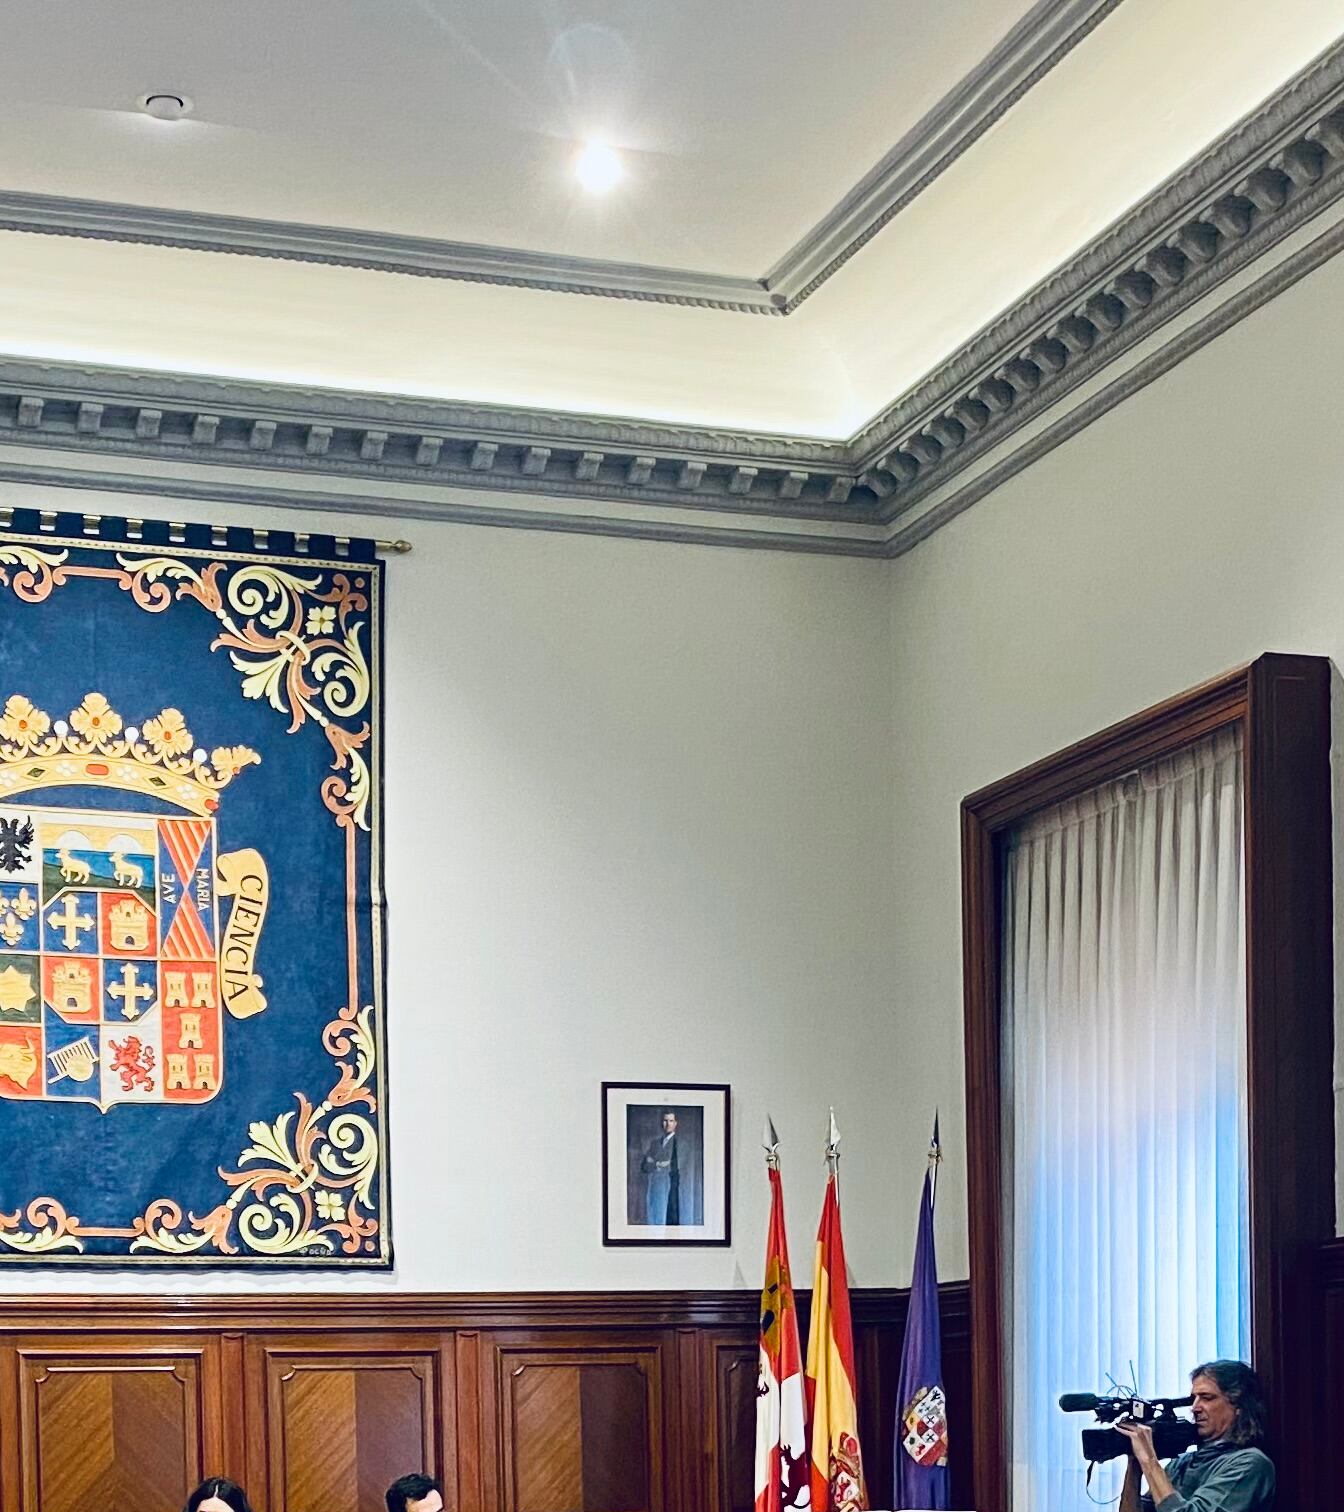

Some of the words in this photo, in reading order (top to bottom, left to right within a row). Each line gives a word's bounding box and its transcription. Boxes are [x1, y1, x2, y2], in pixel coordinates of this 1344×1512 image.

[161, 873, 177, 904] AVE
[196, 868, 210, 912] MARIA
[224, 874, 264, 1001] CIENCIA
